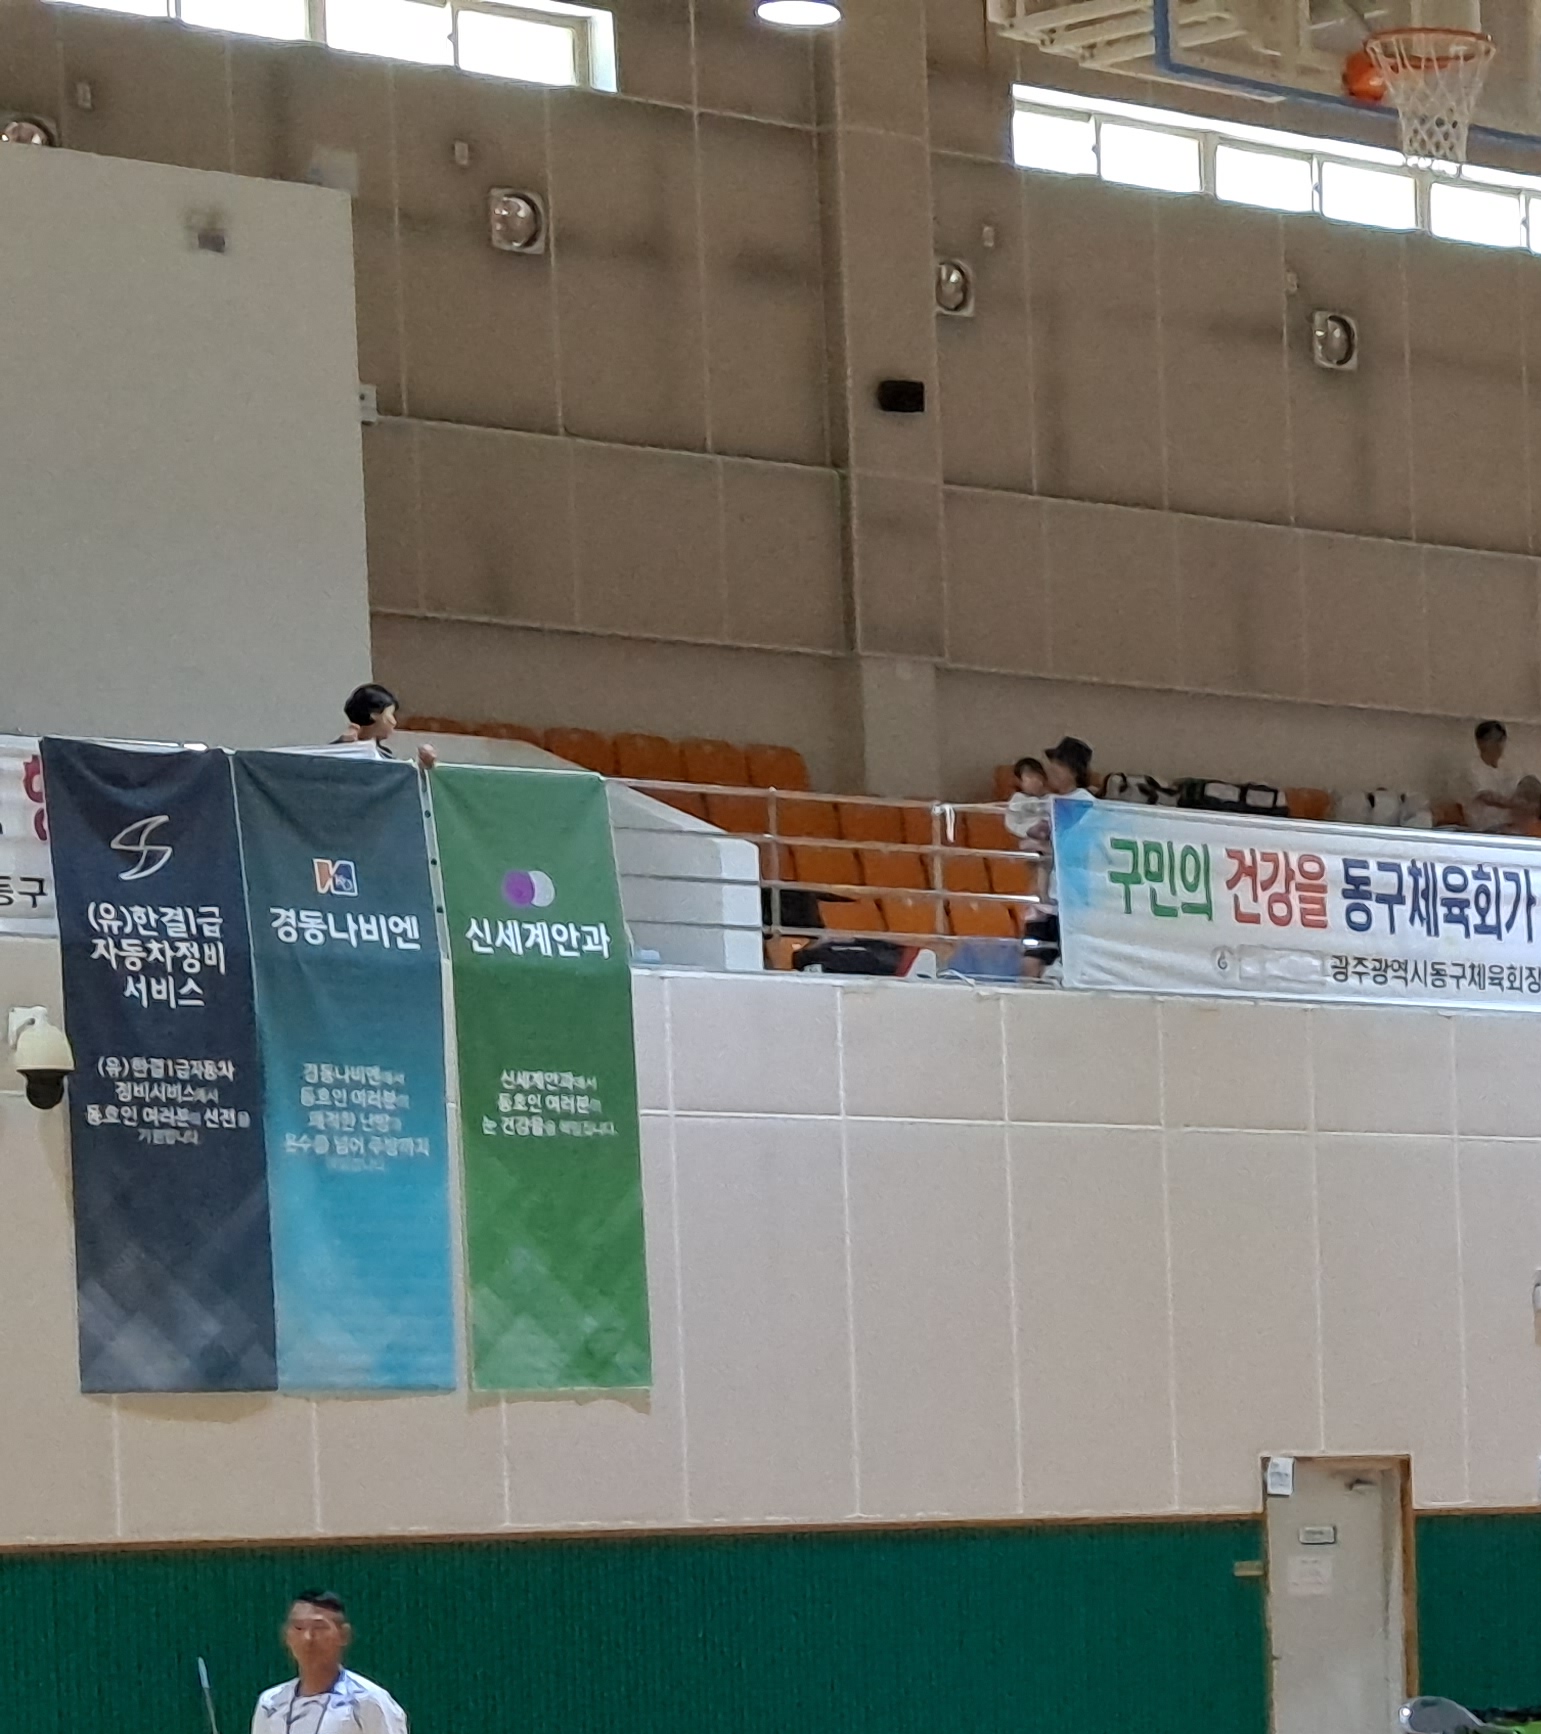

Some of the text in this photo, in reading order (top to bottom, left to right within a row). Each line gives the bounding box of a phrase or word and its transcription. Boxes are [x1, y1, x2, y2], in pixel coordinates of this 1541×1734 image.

[1108, 836, 1215, 922] 구민의
[1223, 847, 1330, 930] 건강을
[1341, 857, 1538, 946] 동구체육회가
[270, 905, 421, 951] 경동나비엔
[465, 916, 611, 959] 신세계안과
[90, 936, 226, 975] 자동차정비
[123, 974, 206, 1009] 서비스
